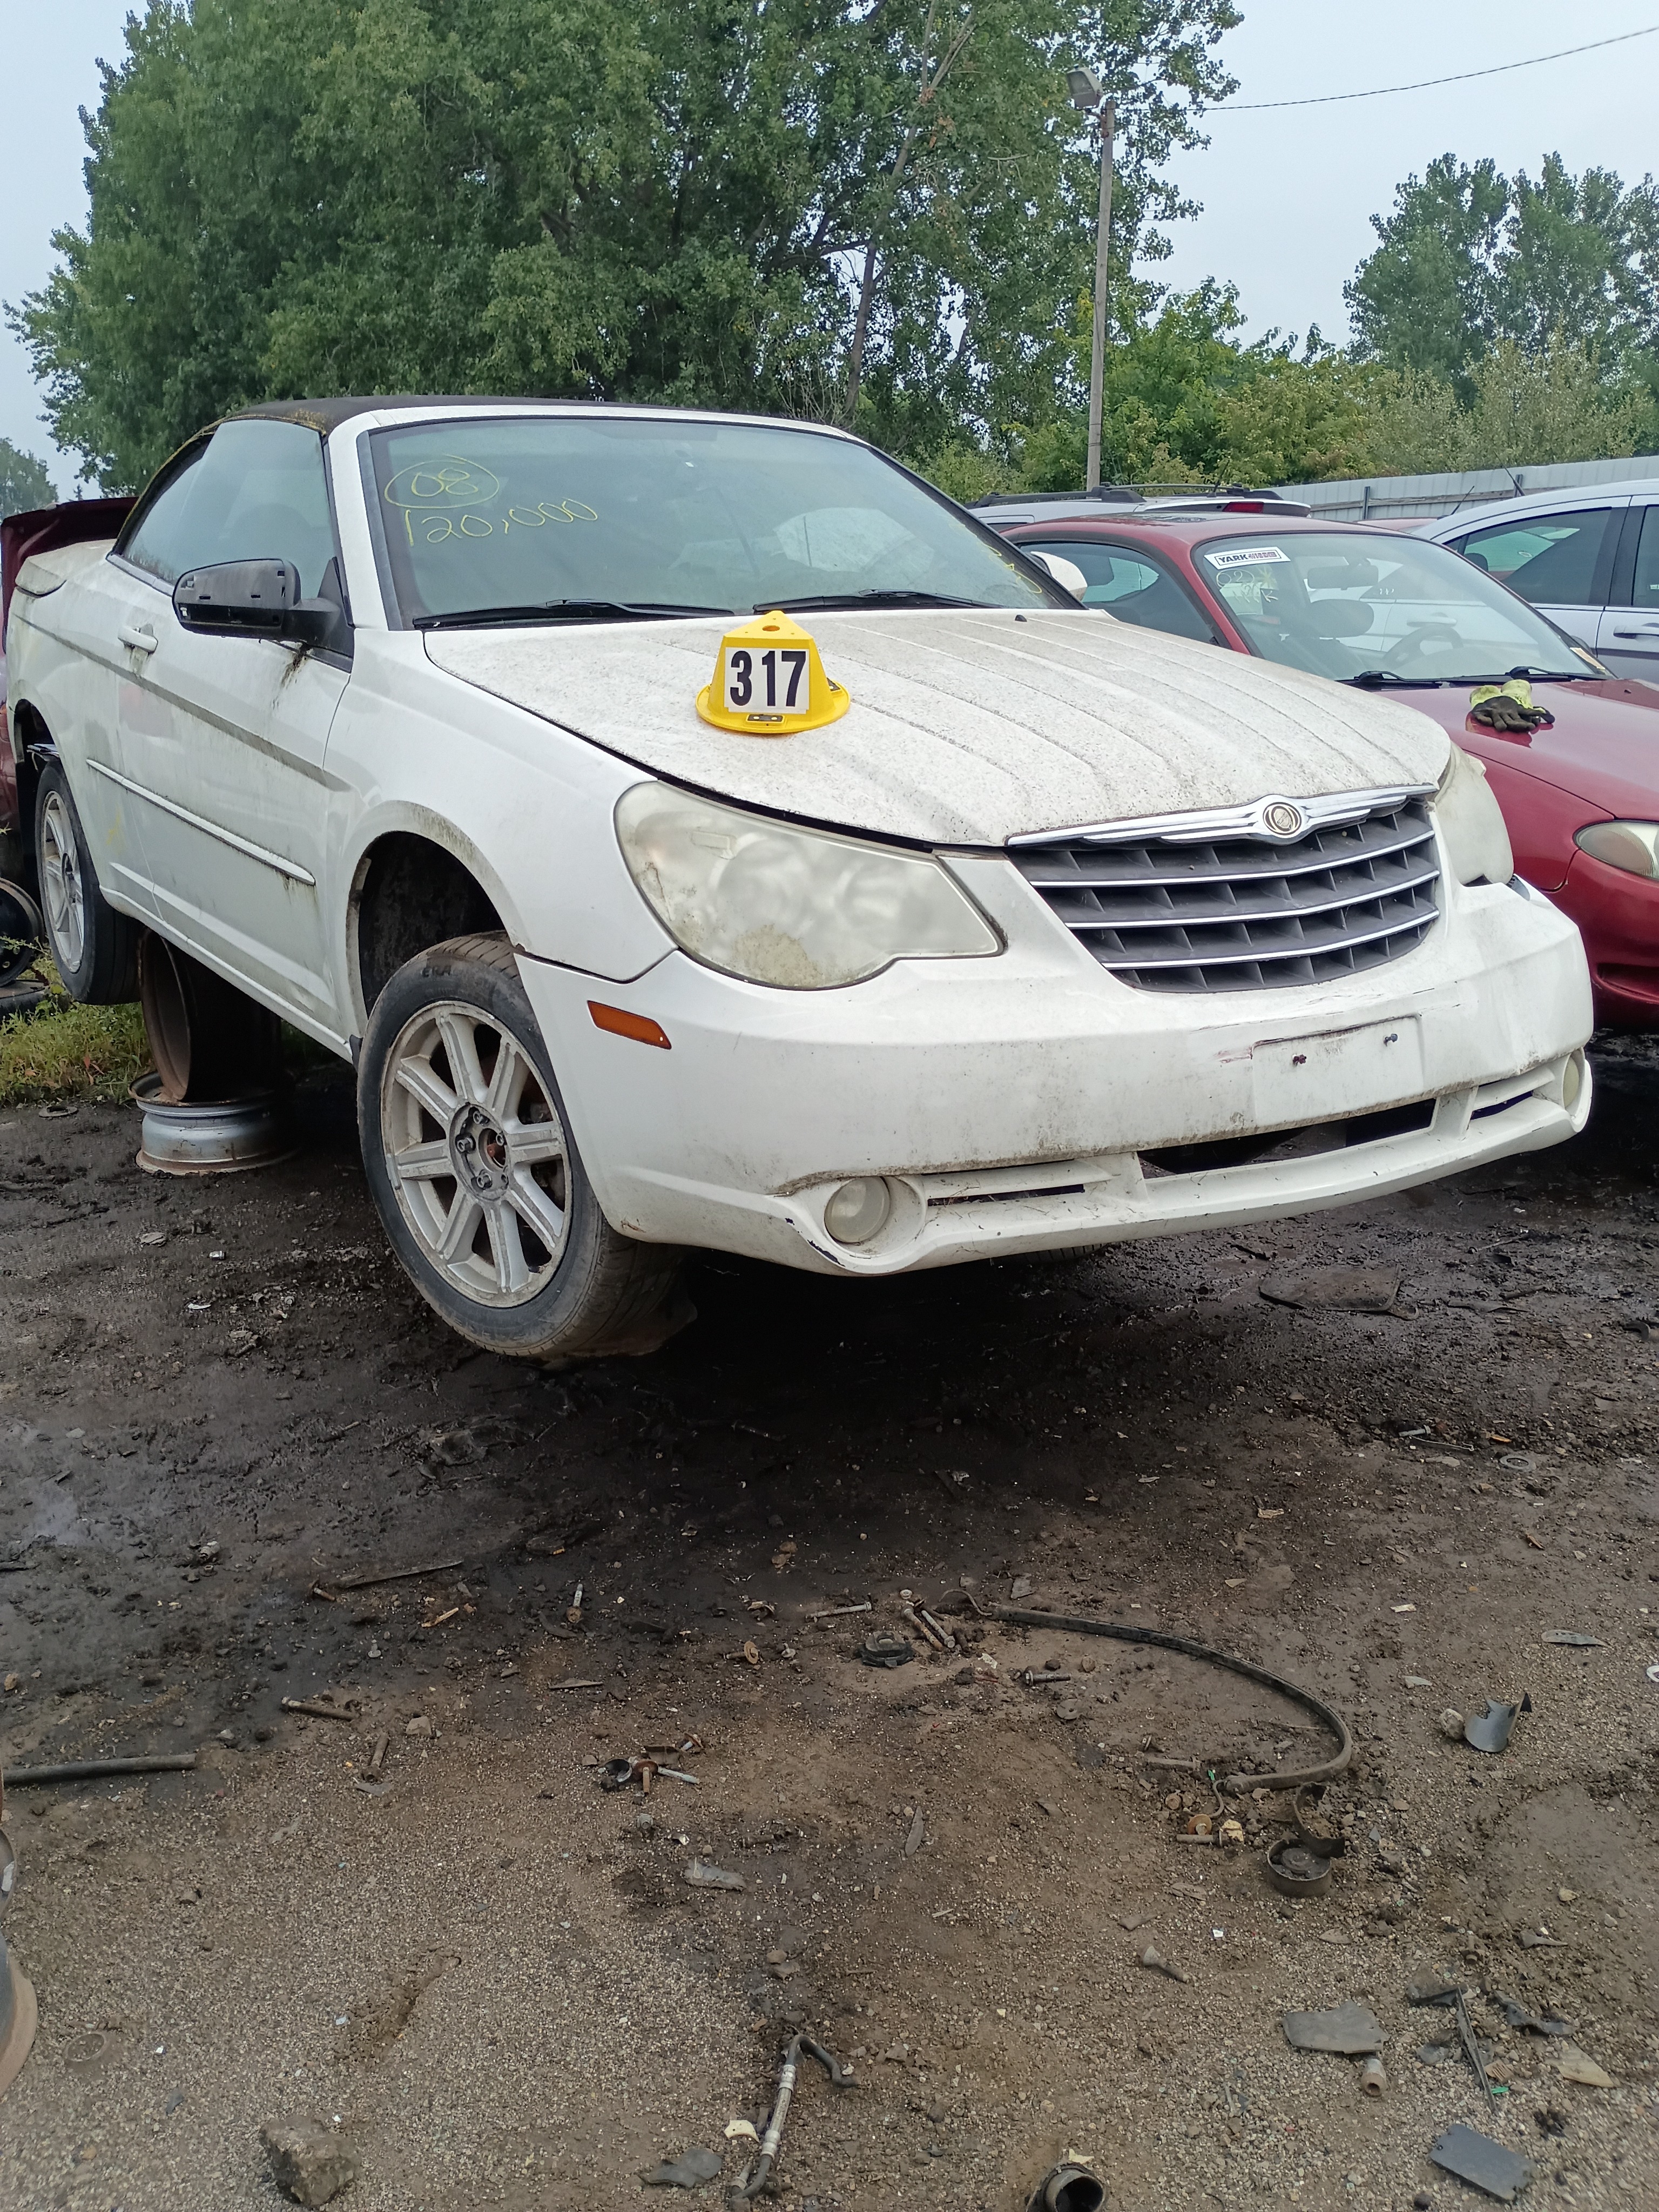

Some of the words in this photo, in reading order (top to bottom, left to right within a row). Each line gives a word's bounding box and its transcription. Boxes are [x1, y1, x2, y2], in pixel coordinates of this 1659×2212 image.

[412, 468, 479, 497] 08
[406, 497, 598, 547] 120,000
[731, 651, 806, 706] 317
